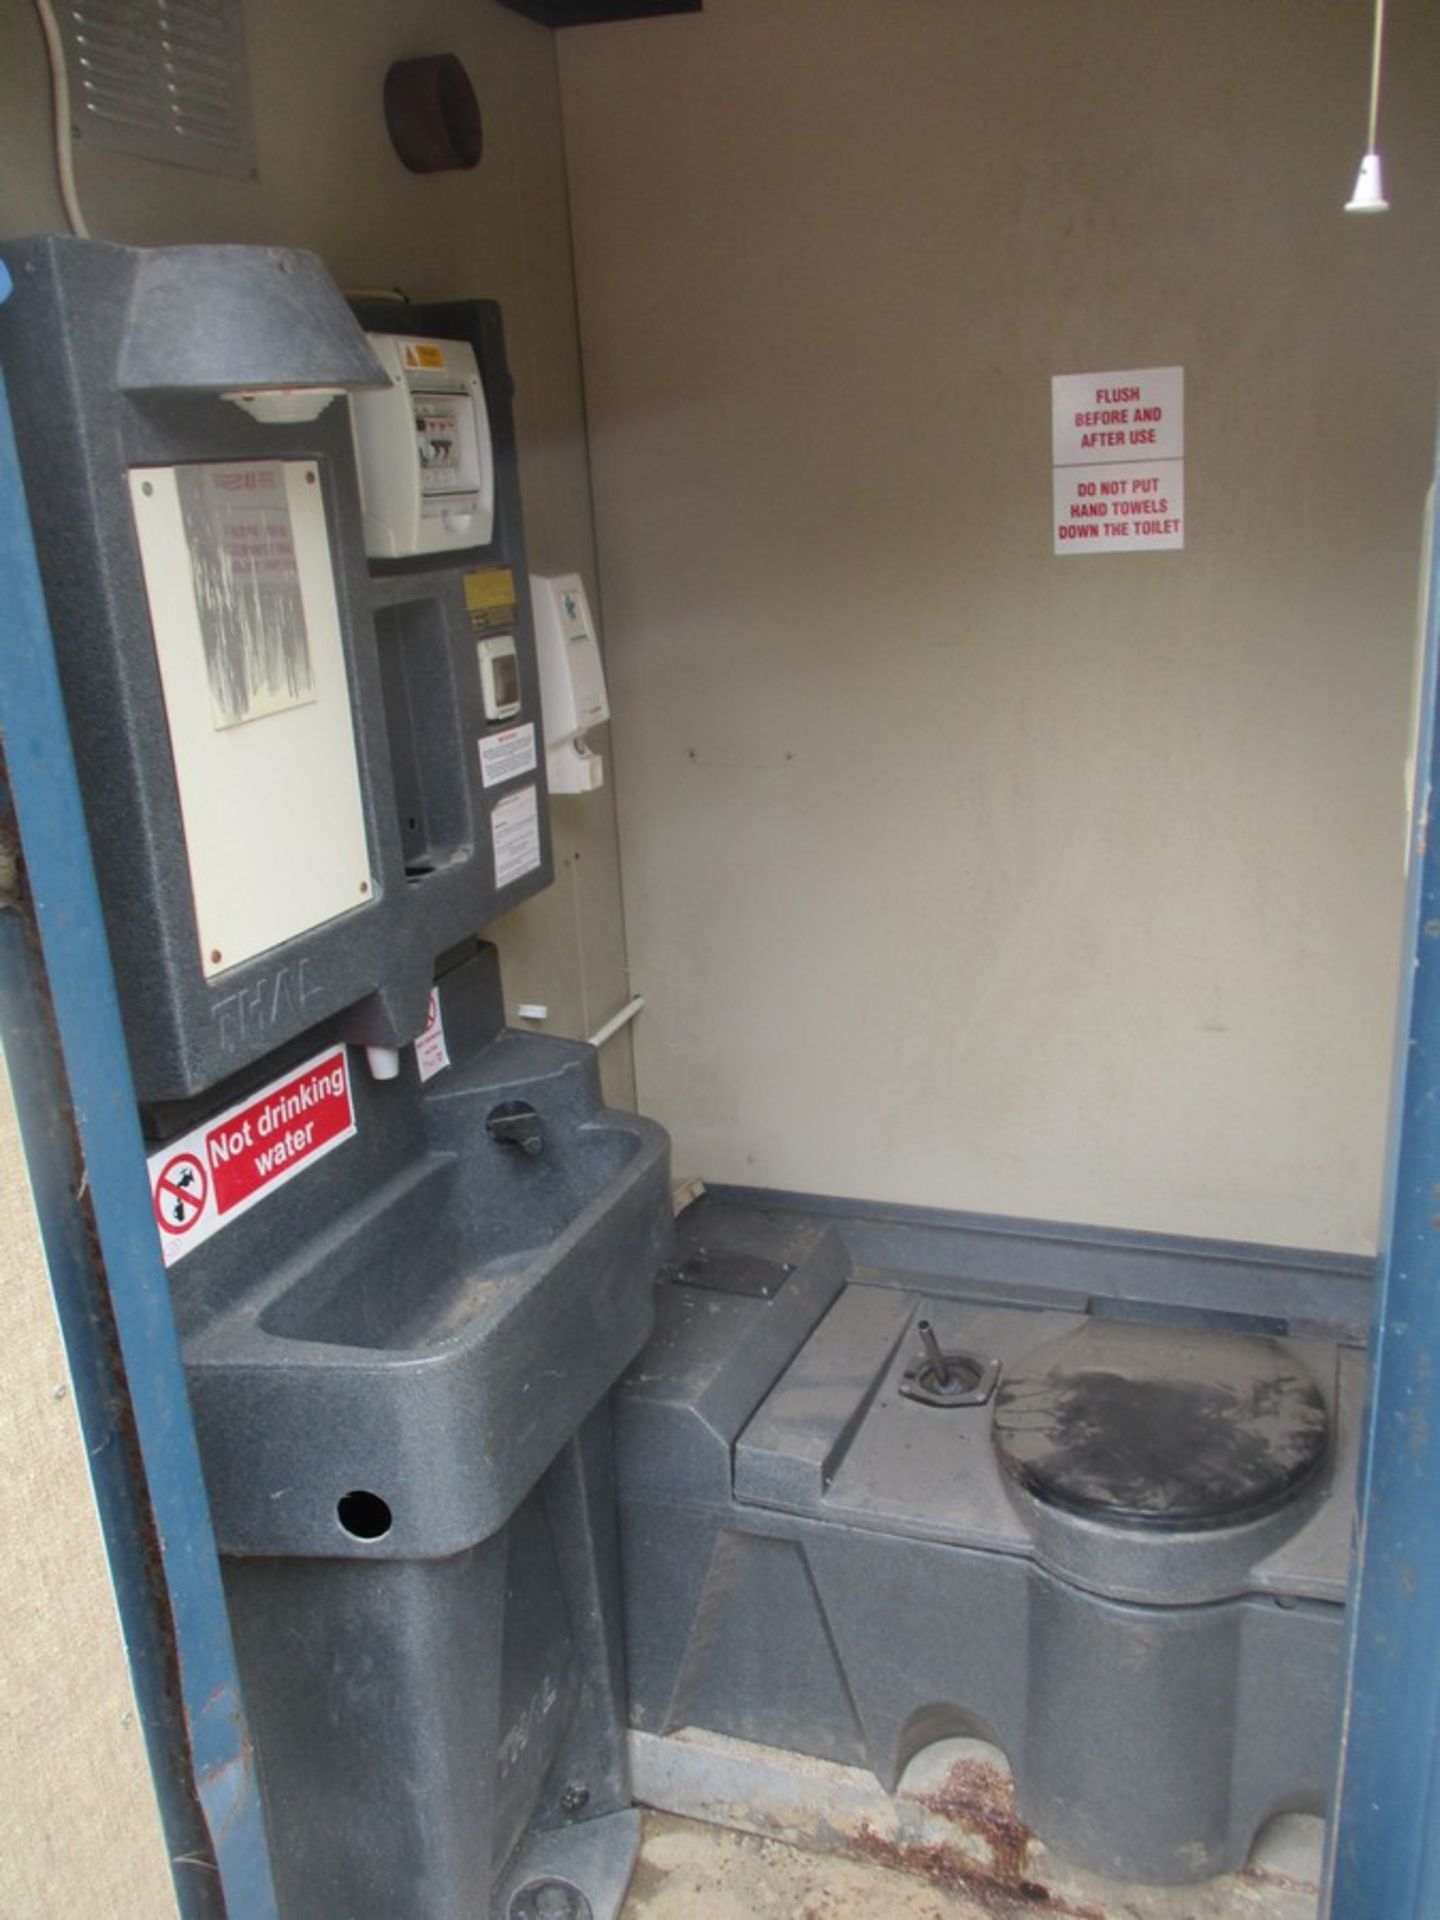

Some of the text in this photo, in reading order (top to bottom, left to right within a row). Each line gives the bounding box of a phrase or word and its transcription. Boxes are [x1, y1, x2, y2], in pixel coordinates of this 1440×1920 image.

[1096, 388, 1140, 404] FLUSH
[1075, 407, 1162, 427] BEFORE AND
[1081, 428, 1157, 448] AFTER USE
[1077, 478, 1160, 498] DO NOT PUT
[1070, 499, 1168, 519] HAND TOWELS
[1058, 519, 1180, 540] DOWN THE TOILET
[209, 1067, 345, 1168] Not drinking
[254, 1121, 316, 1177] water
